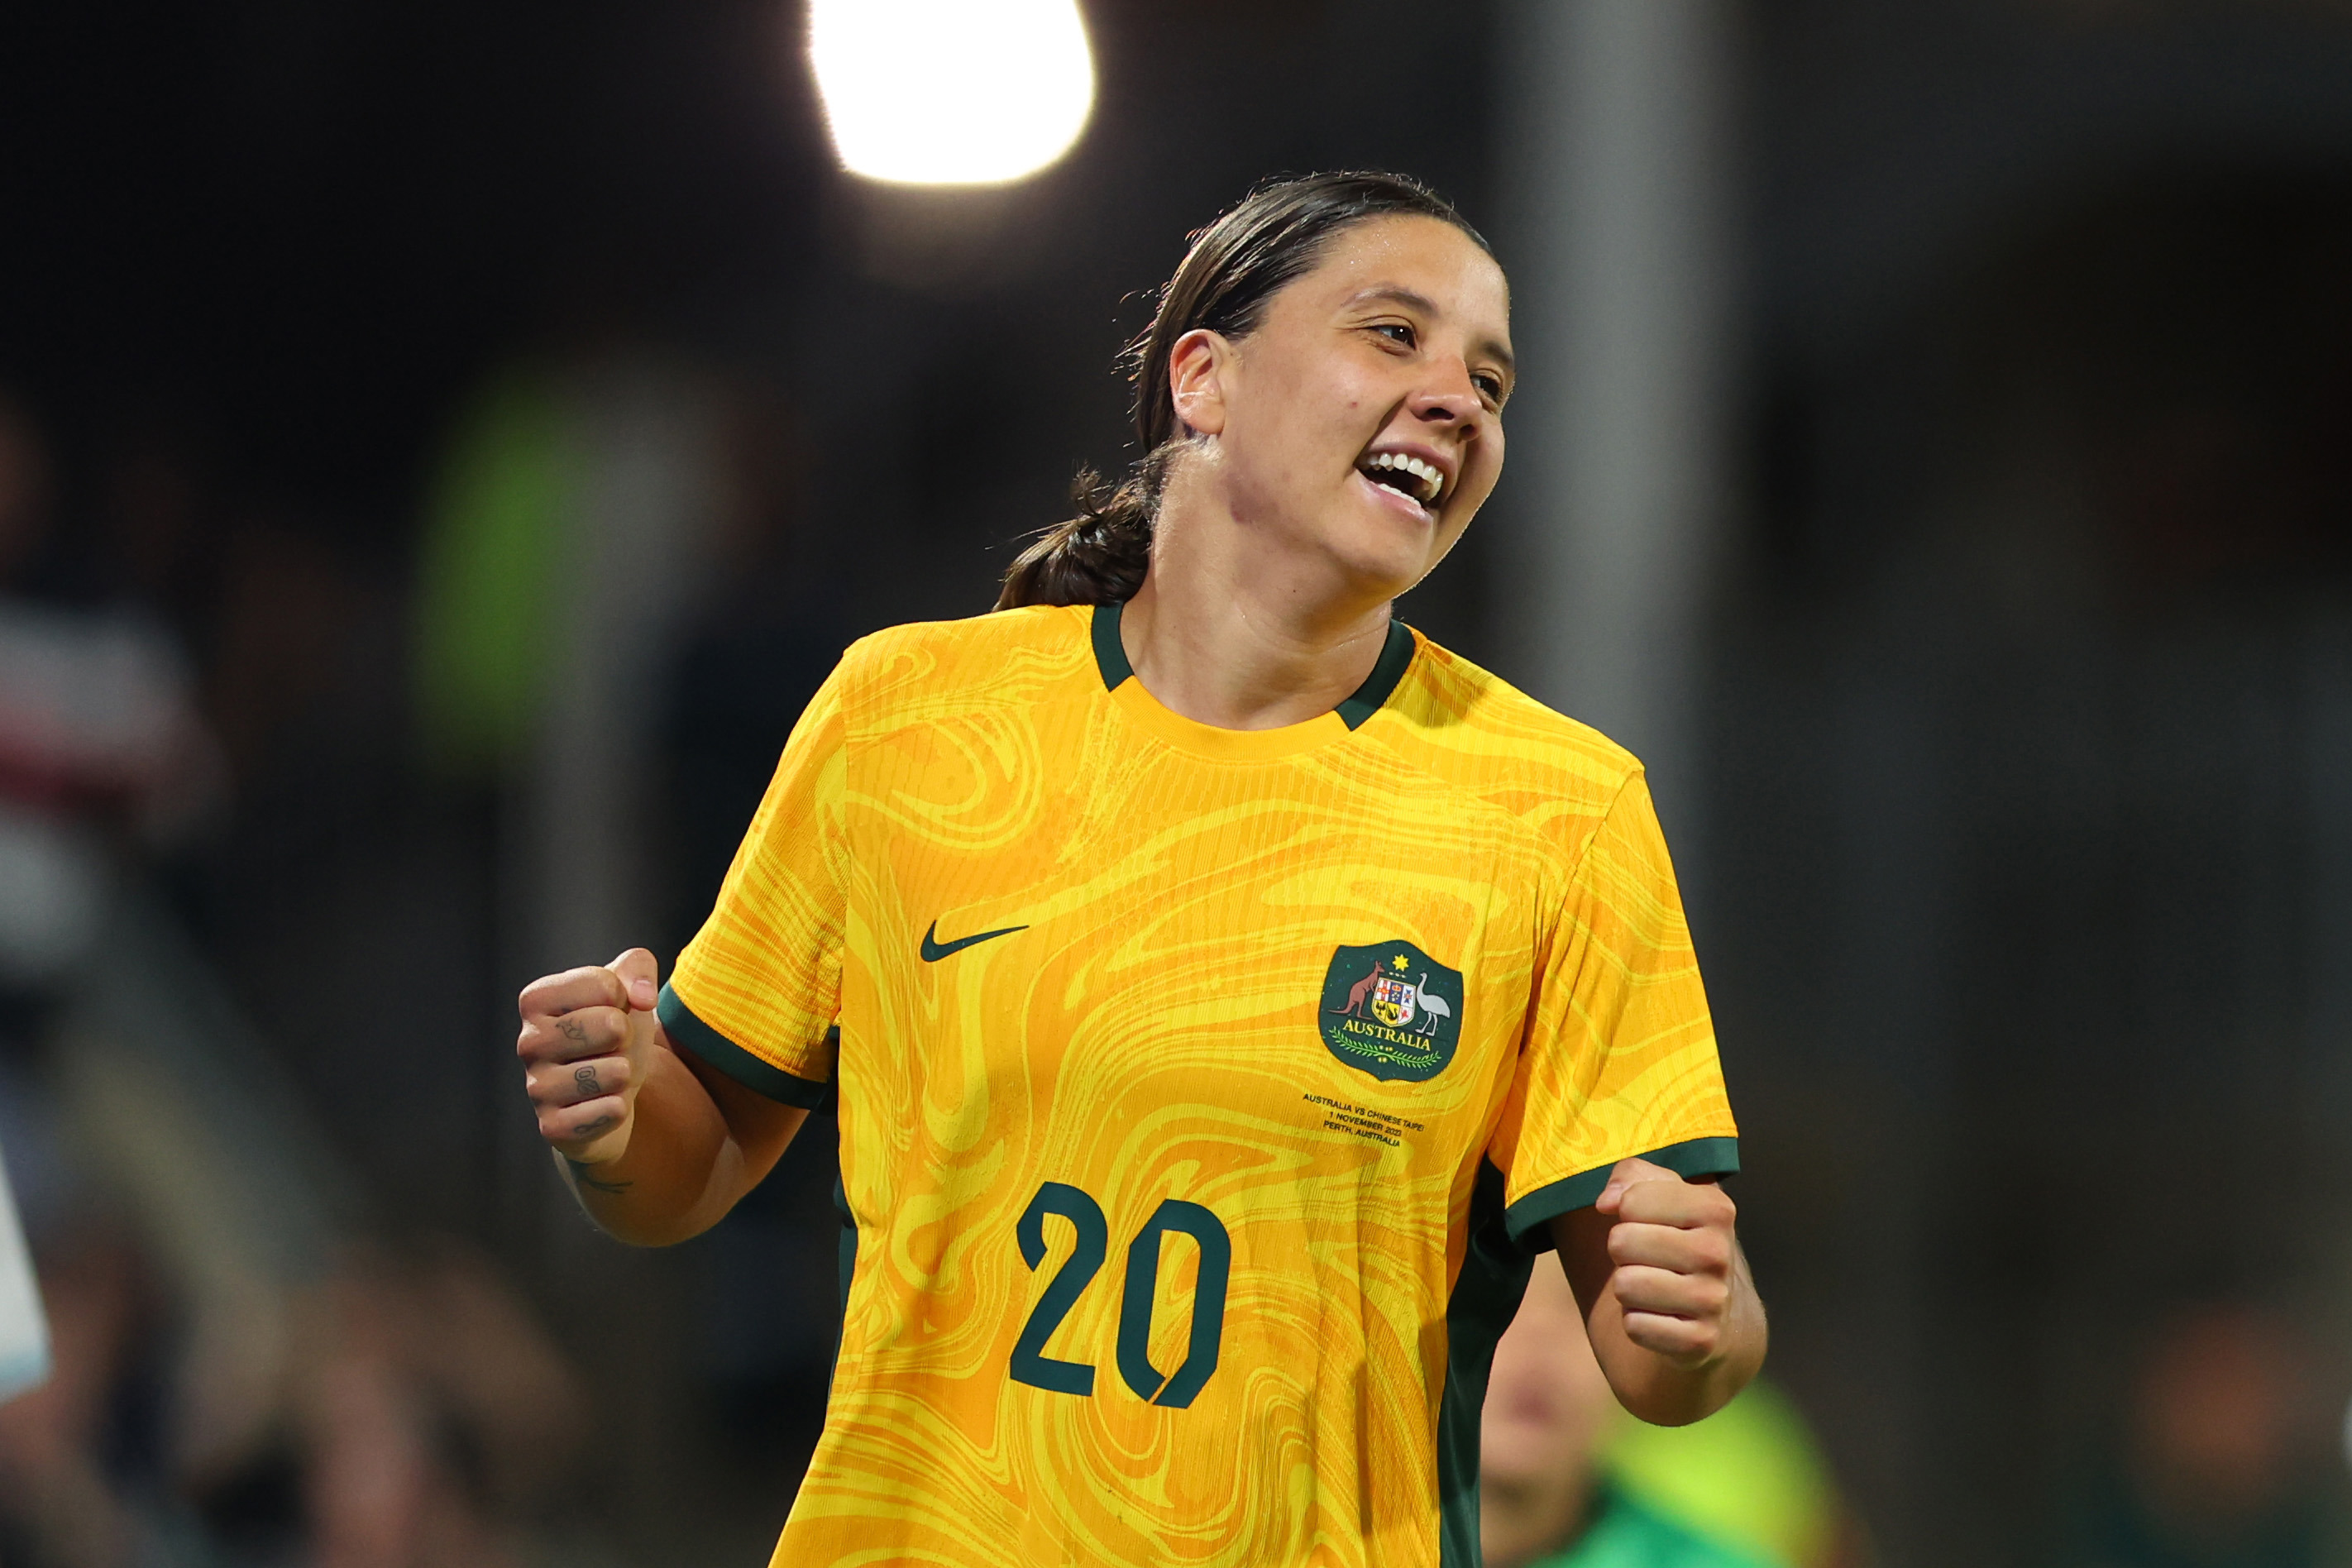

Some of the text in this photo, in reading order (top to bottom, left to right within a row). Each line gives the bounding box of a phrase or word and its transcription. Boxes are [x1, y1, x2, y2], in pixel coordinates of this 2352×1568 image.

[1342, 1019, 1431, 1051] AUSTRALIA
[1303, 1093, 1425, 1132] AUSTRALIA VS CHINESE TAIPEI
[1336, 1112, 1384, 1131] NOVEMBER
[1323, 1120, 1400, 1147] PERTH, AUSTRALIA
[1010, 1181, 1231, 1409] 20
